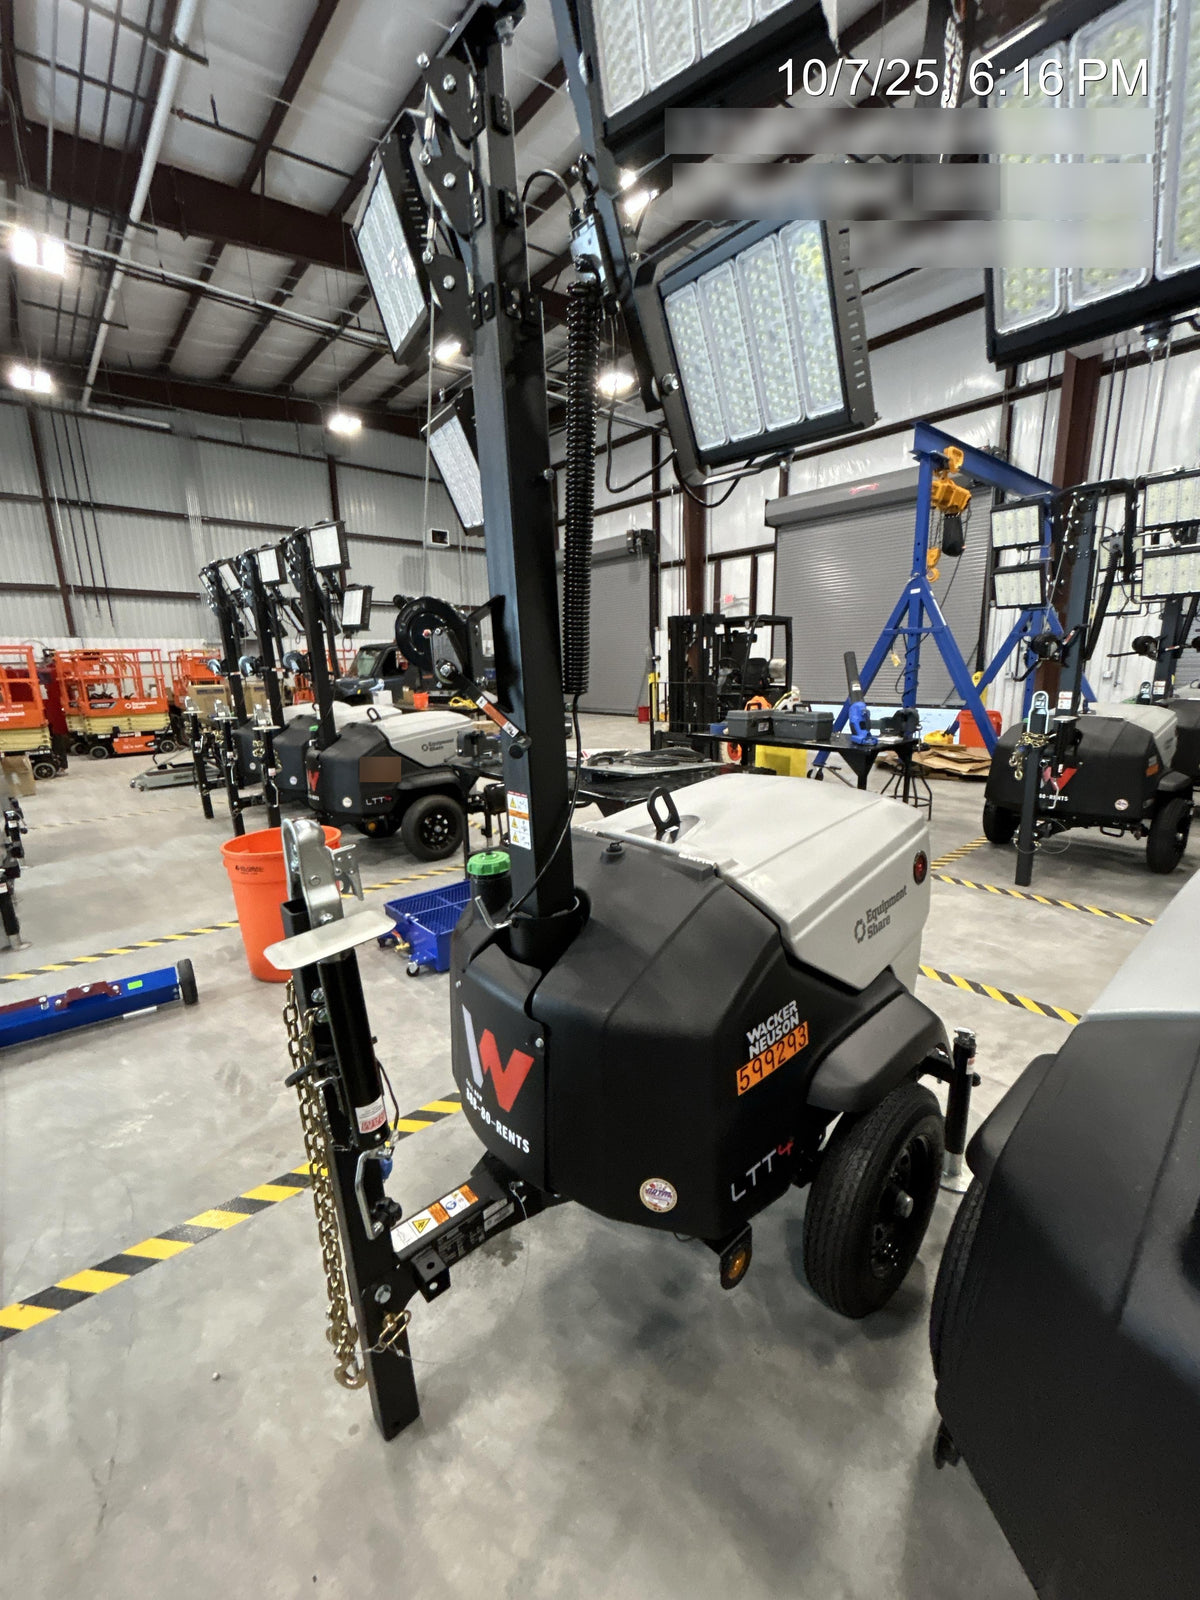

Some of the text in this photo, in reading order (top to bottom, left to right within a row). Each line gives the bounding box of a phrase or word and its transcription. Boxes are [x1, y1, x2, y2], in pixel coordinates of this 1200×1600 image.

[866, 885, 907, 923] Equipment
[867, 915, 891, 939] Share
[746, 1000, 798, 1044] WACKER
[749, 1012, 799, 1060] NEUSON
[739, 1024, 807, 1091] 599293
[730, 1139, 794, 1202] LTT4
